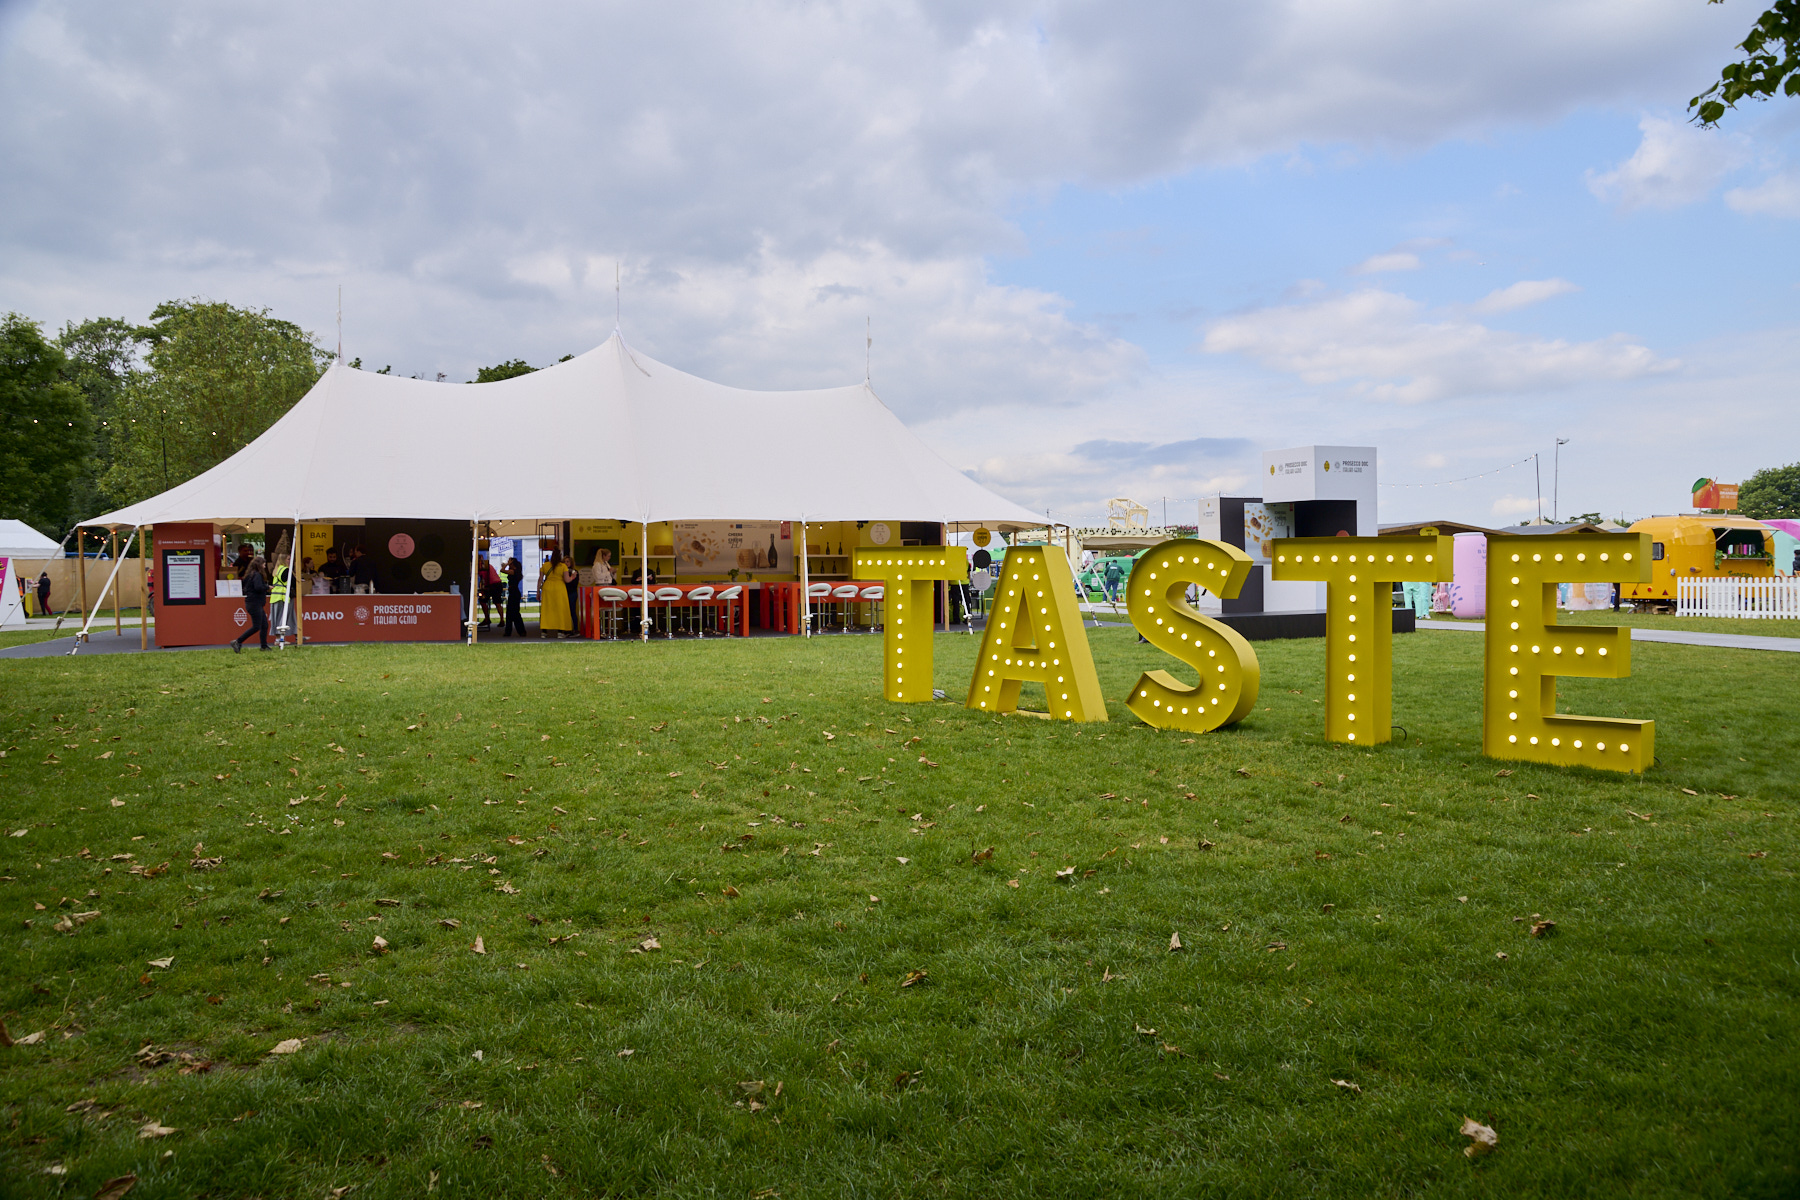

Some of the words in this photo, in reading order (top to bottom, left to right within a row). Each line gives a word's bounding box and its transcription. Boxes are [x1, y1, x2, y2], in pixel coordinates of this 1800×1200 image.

[374, 605, 414, 614] PROSECCO
[415, 604, 432, 613] DOC
[374, 616, 398, 625] ITALIAN
[399, 615, 418, 625] GENIO
[852, 532, 1656, 775] TASTE
